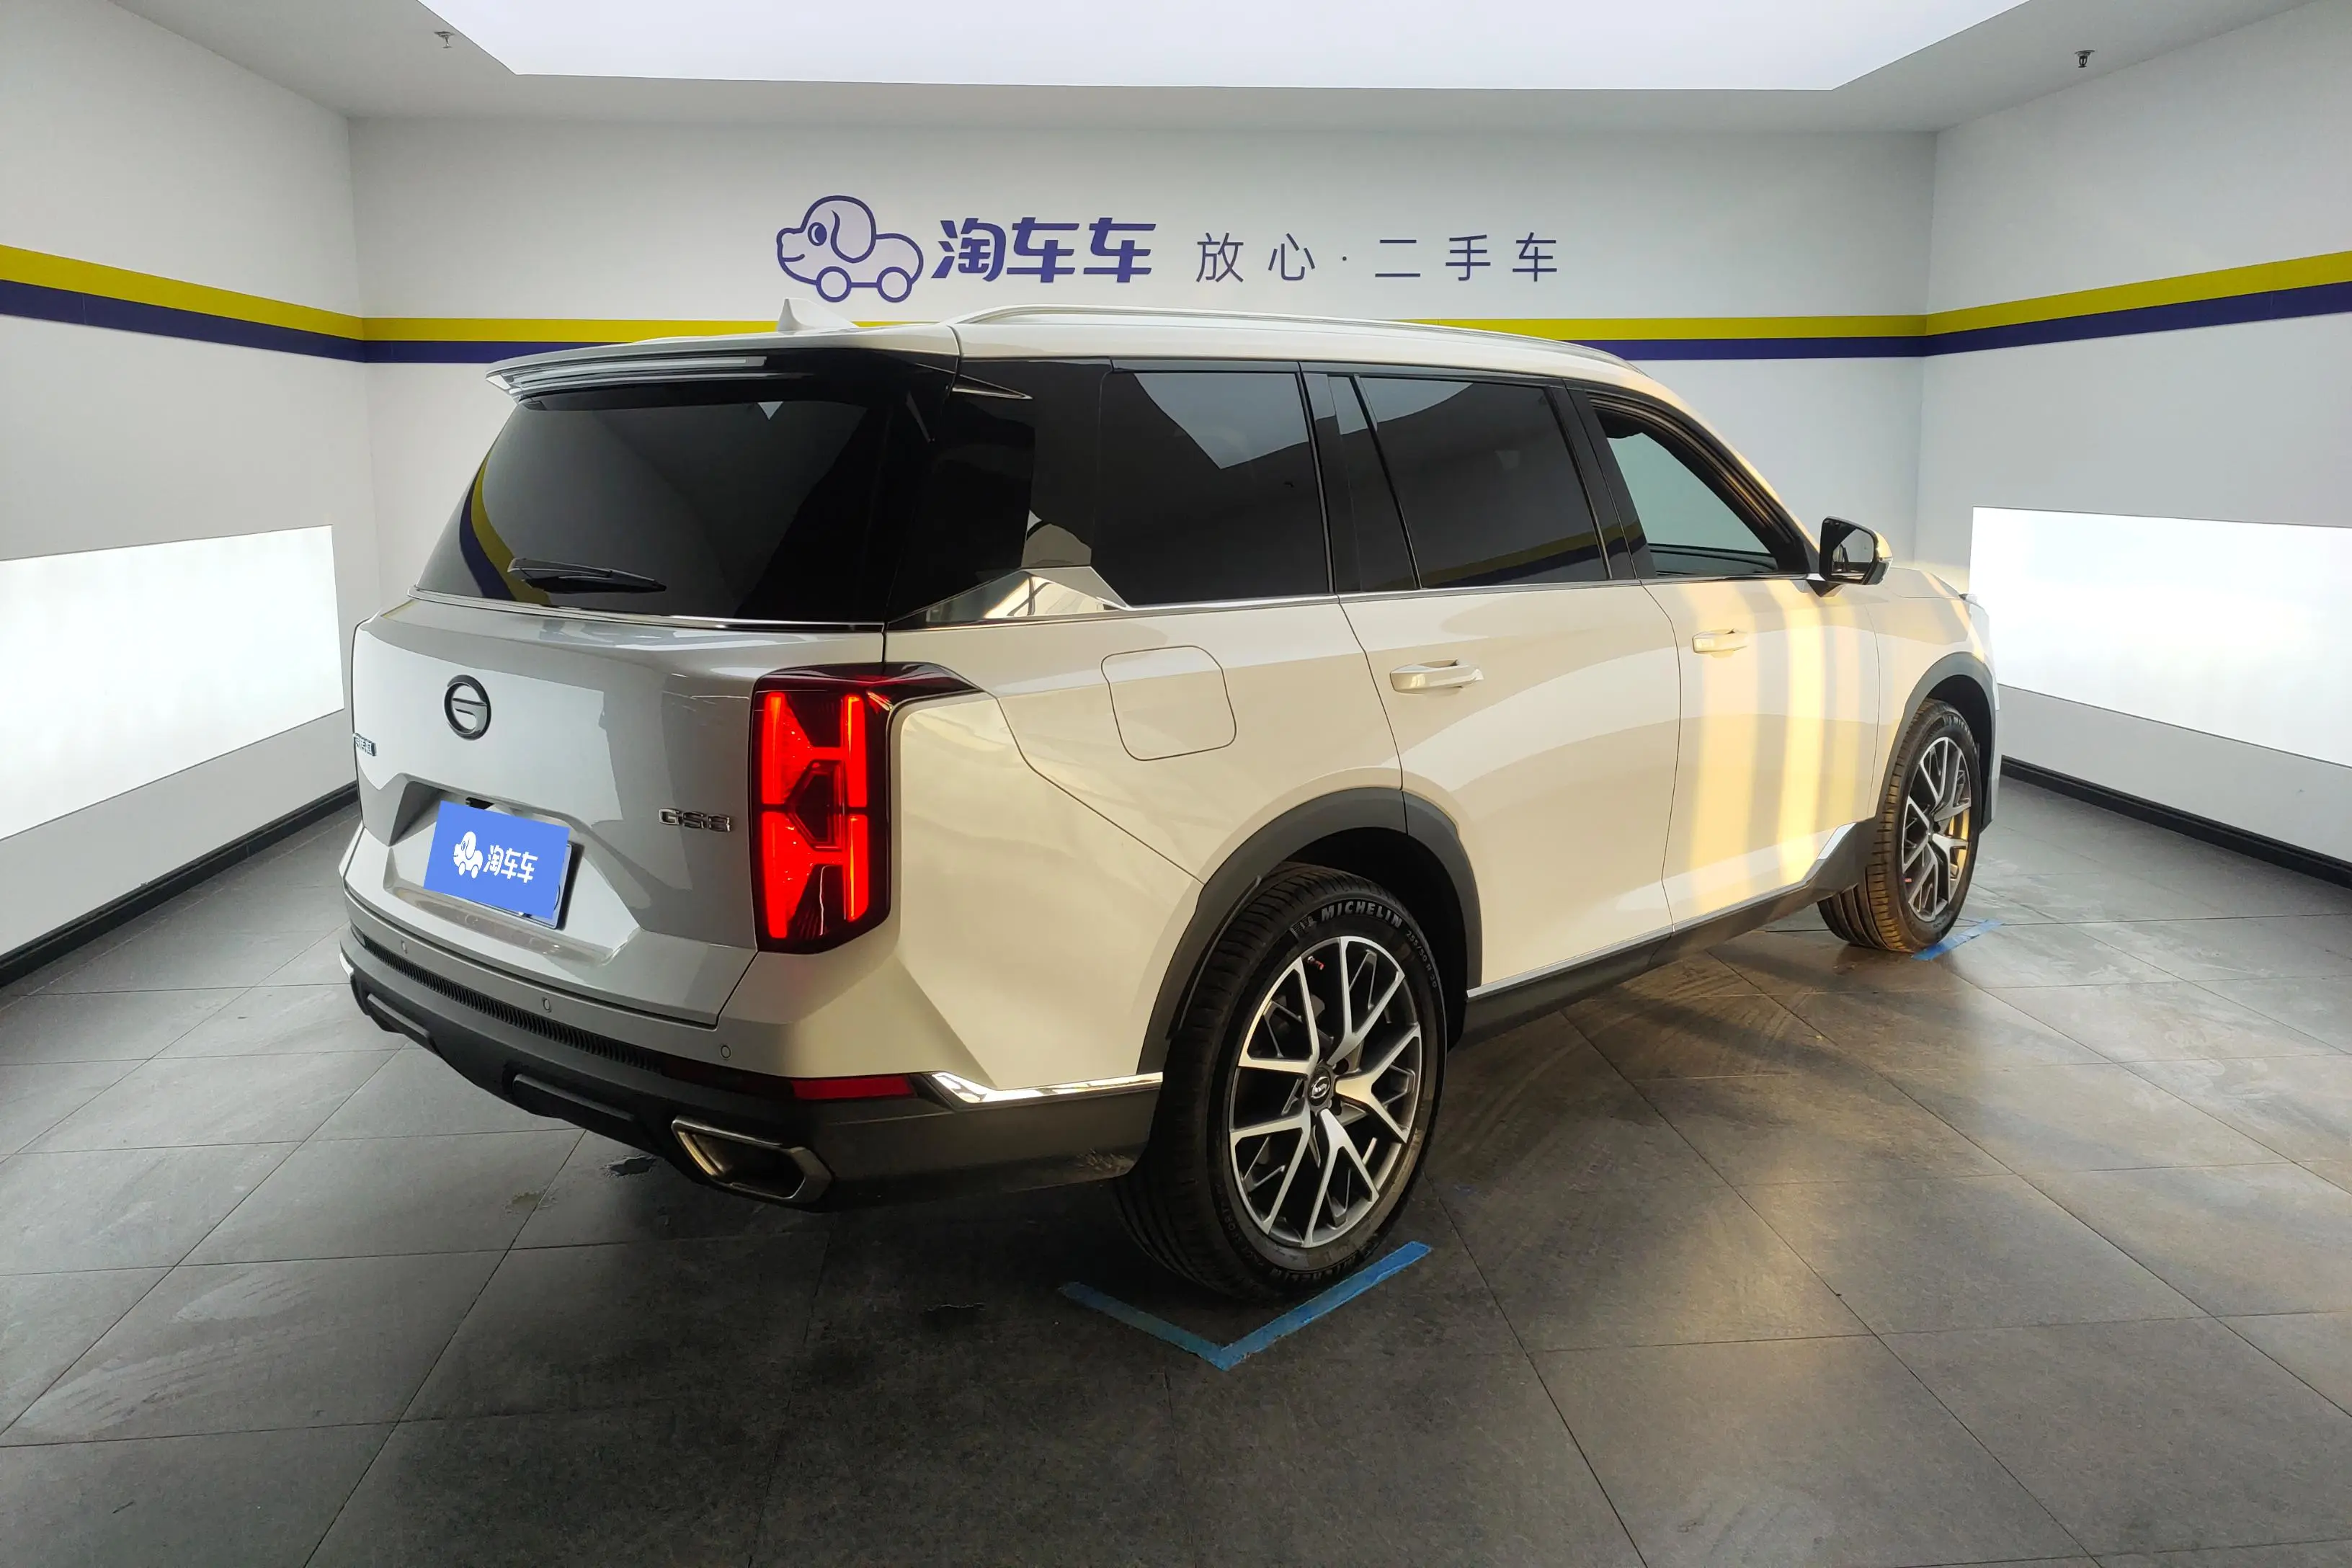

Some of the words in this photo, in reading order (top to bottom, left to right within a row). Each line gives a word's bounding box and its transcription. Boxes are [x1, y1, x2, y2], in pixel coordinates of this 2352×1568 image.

[930, 217, 1157, 282] 淘车车
[658, 808, 732, 832] GS8
[1321, 901, 1402, 928] MICHELIN
